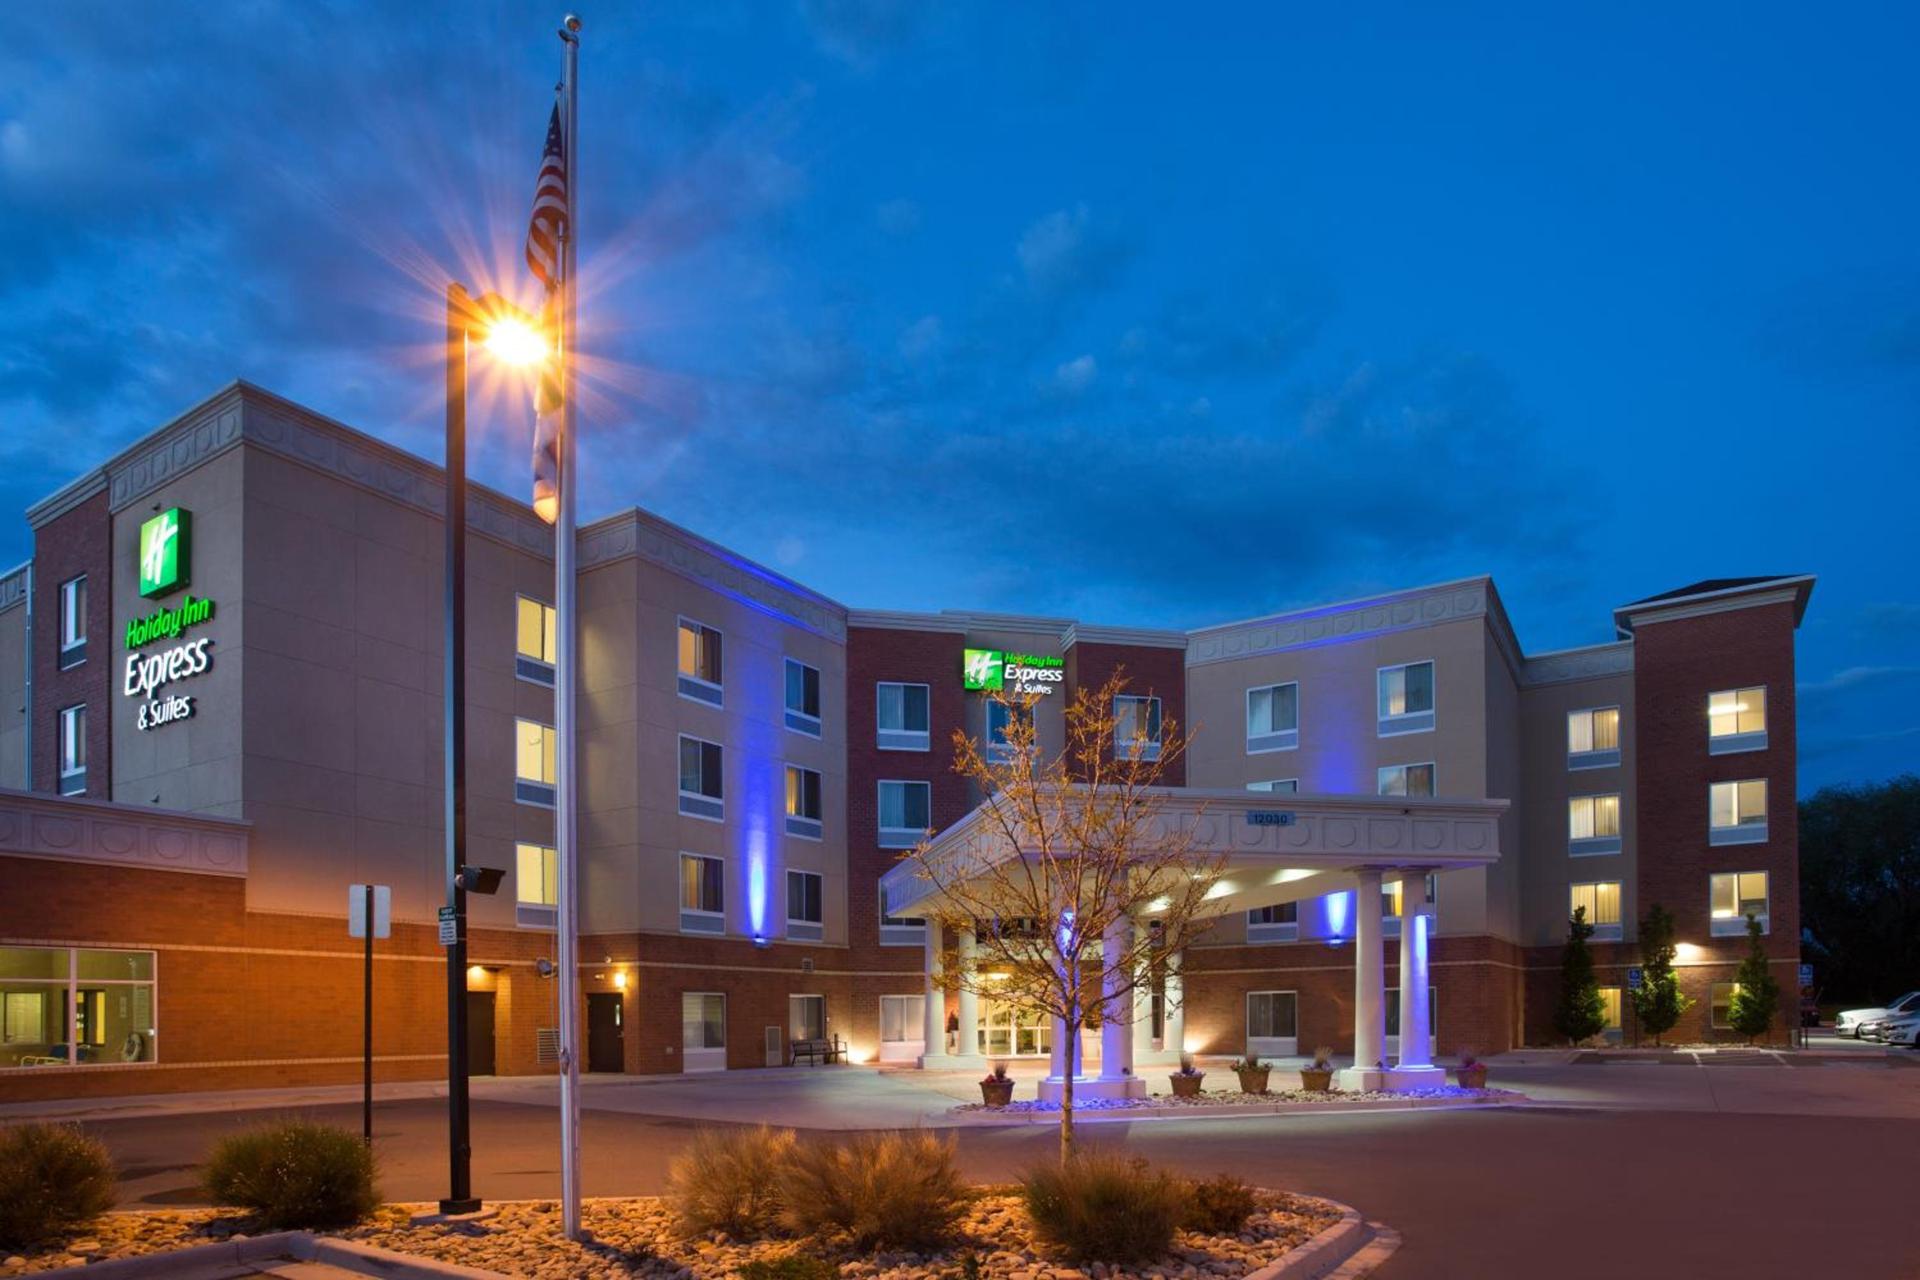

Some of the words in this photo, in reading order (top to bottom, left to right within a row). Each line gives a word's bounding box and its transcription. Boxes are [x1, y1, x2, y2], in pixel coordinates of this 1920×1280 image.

[126, 607, 182, 649] Holiday
[183, 595, 210, 626] Inn
[124, 637, 209, 699] Express
[1004, 664, 1064, 683] Express
[1046, 655, 1064, 666] Inn
[1023, 683, 1052, 695] Suites
[138, 704, 149, 730] &
[149, 695, 191, 727] Suites
